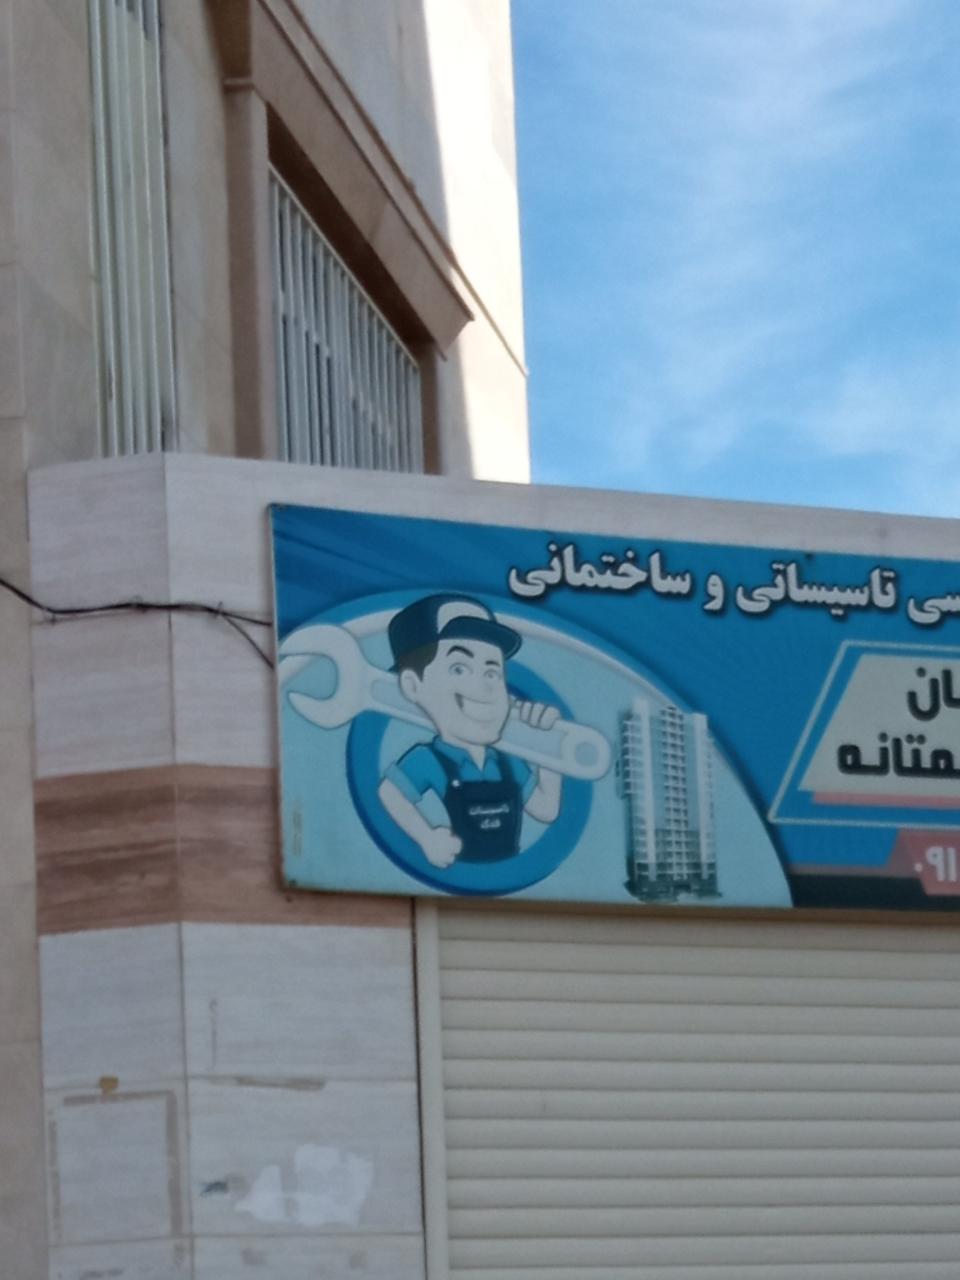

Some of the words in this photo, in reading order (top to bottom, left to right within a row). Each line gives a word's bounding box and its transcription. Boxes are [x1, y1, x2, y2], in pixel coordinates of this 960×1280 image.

[508, 543, 692, 597] ساختمانی
[703, 573, 726, 611] و
[736, 561, 898, 616] تاسیساتی
